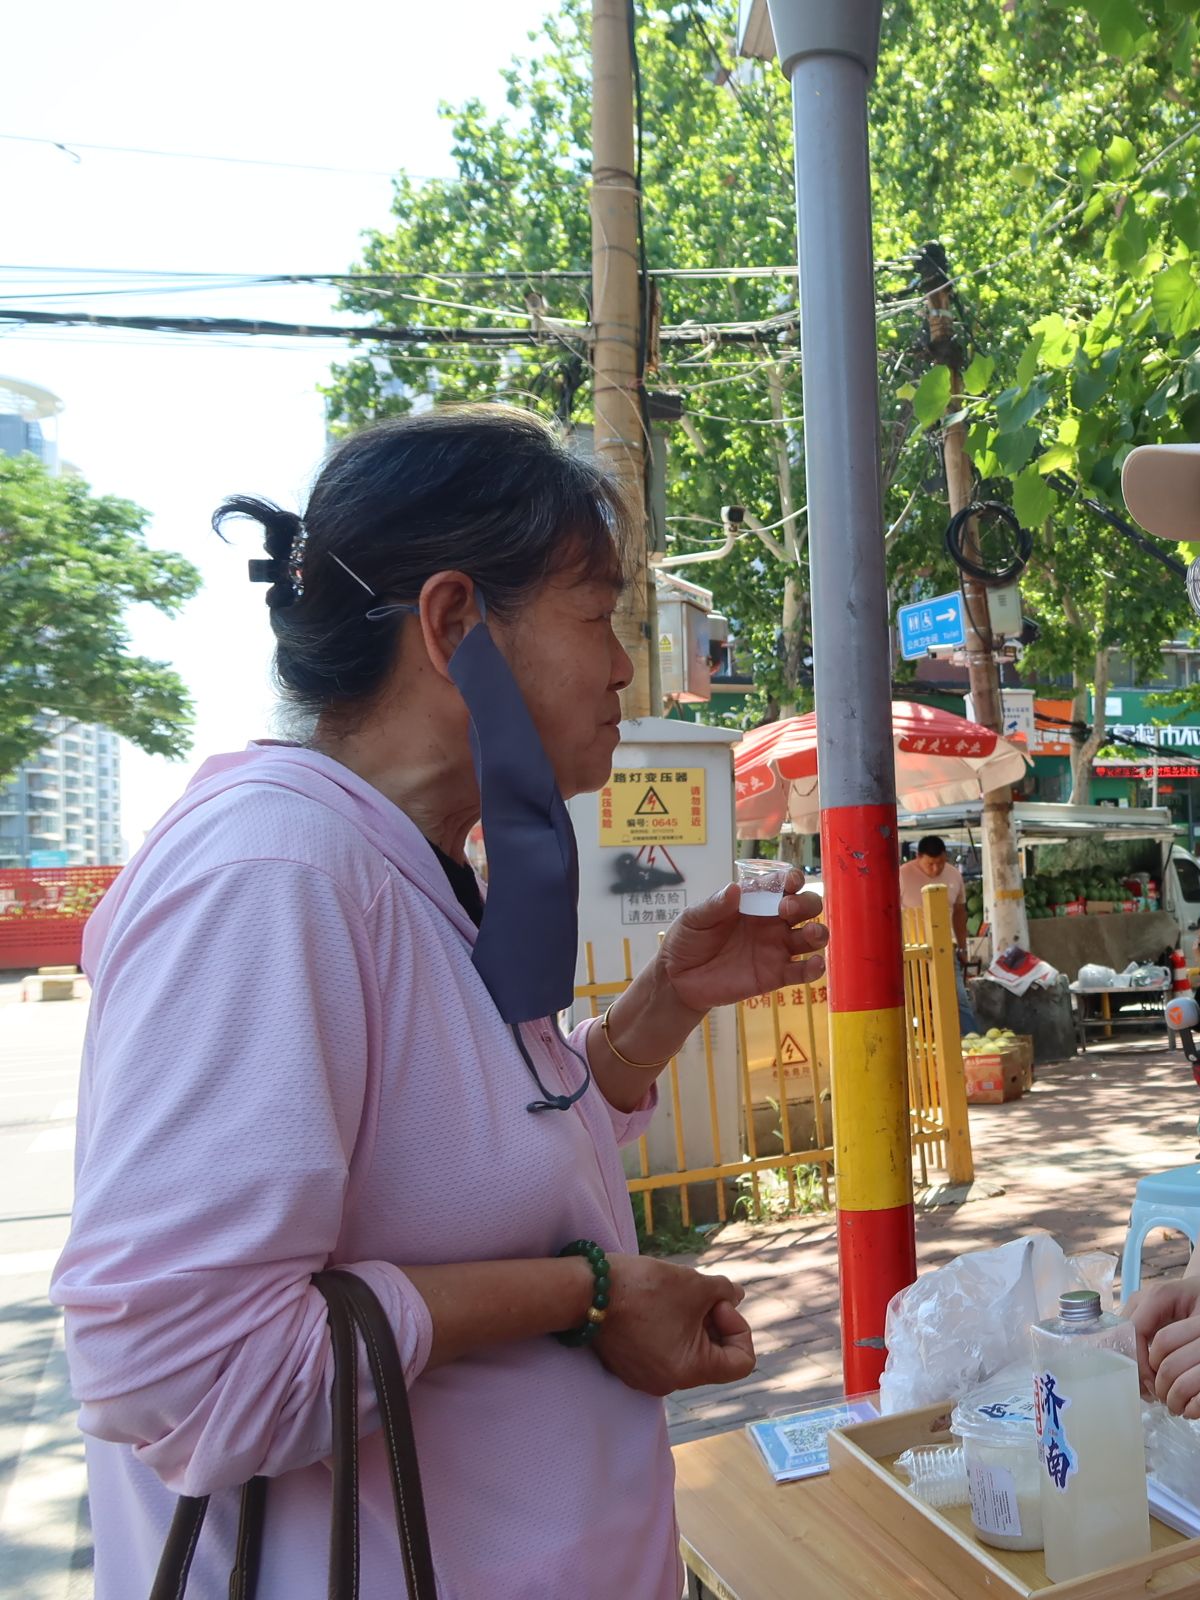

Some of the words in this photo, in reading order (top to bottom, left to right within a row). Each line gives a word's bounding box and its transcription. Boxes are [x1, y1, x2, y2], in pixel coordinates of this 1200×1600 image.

[613, 772, 688, 783] 路灯变压器
[602, 787, 612, 829] 高压危险
[690, 786, 701, 827] 请勿靠近
[652, 818, 678, 828] 0645
[628, 909, 681, 922] 请勿靠近
